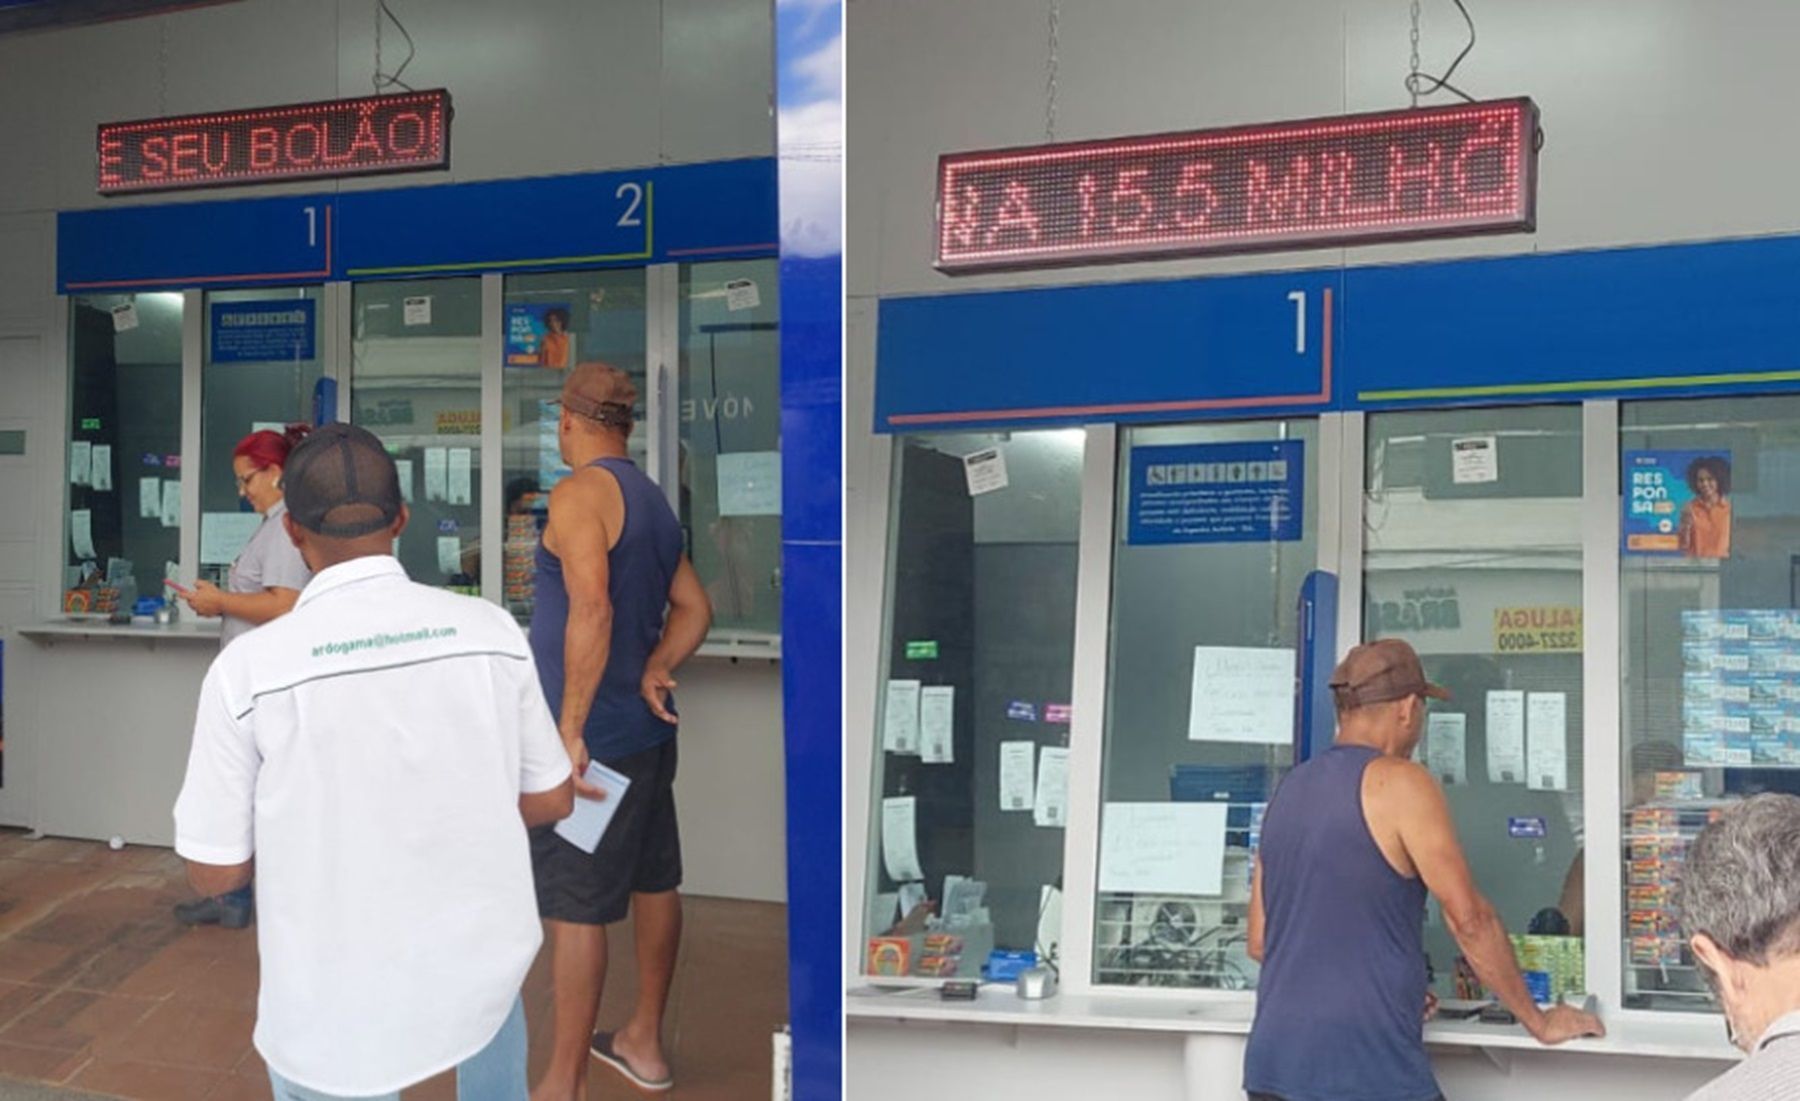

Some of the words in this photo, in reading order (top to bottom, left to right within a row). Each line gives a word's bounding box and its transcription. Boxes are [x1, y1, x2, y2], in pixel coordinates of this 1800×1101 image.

[142, 129, 230, 178] SEU
[615, 182, 644, 227] 2
[1078, 163, 1219, 237] 15.5
[304, 207, 317, 247] 1
[1287, 291, 1306, 353] 1
[1632, 472, 1663, 486] RES
[1632, 487, 1668, 500] PON
